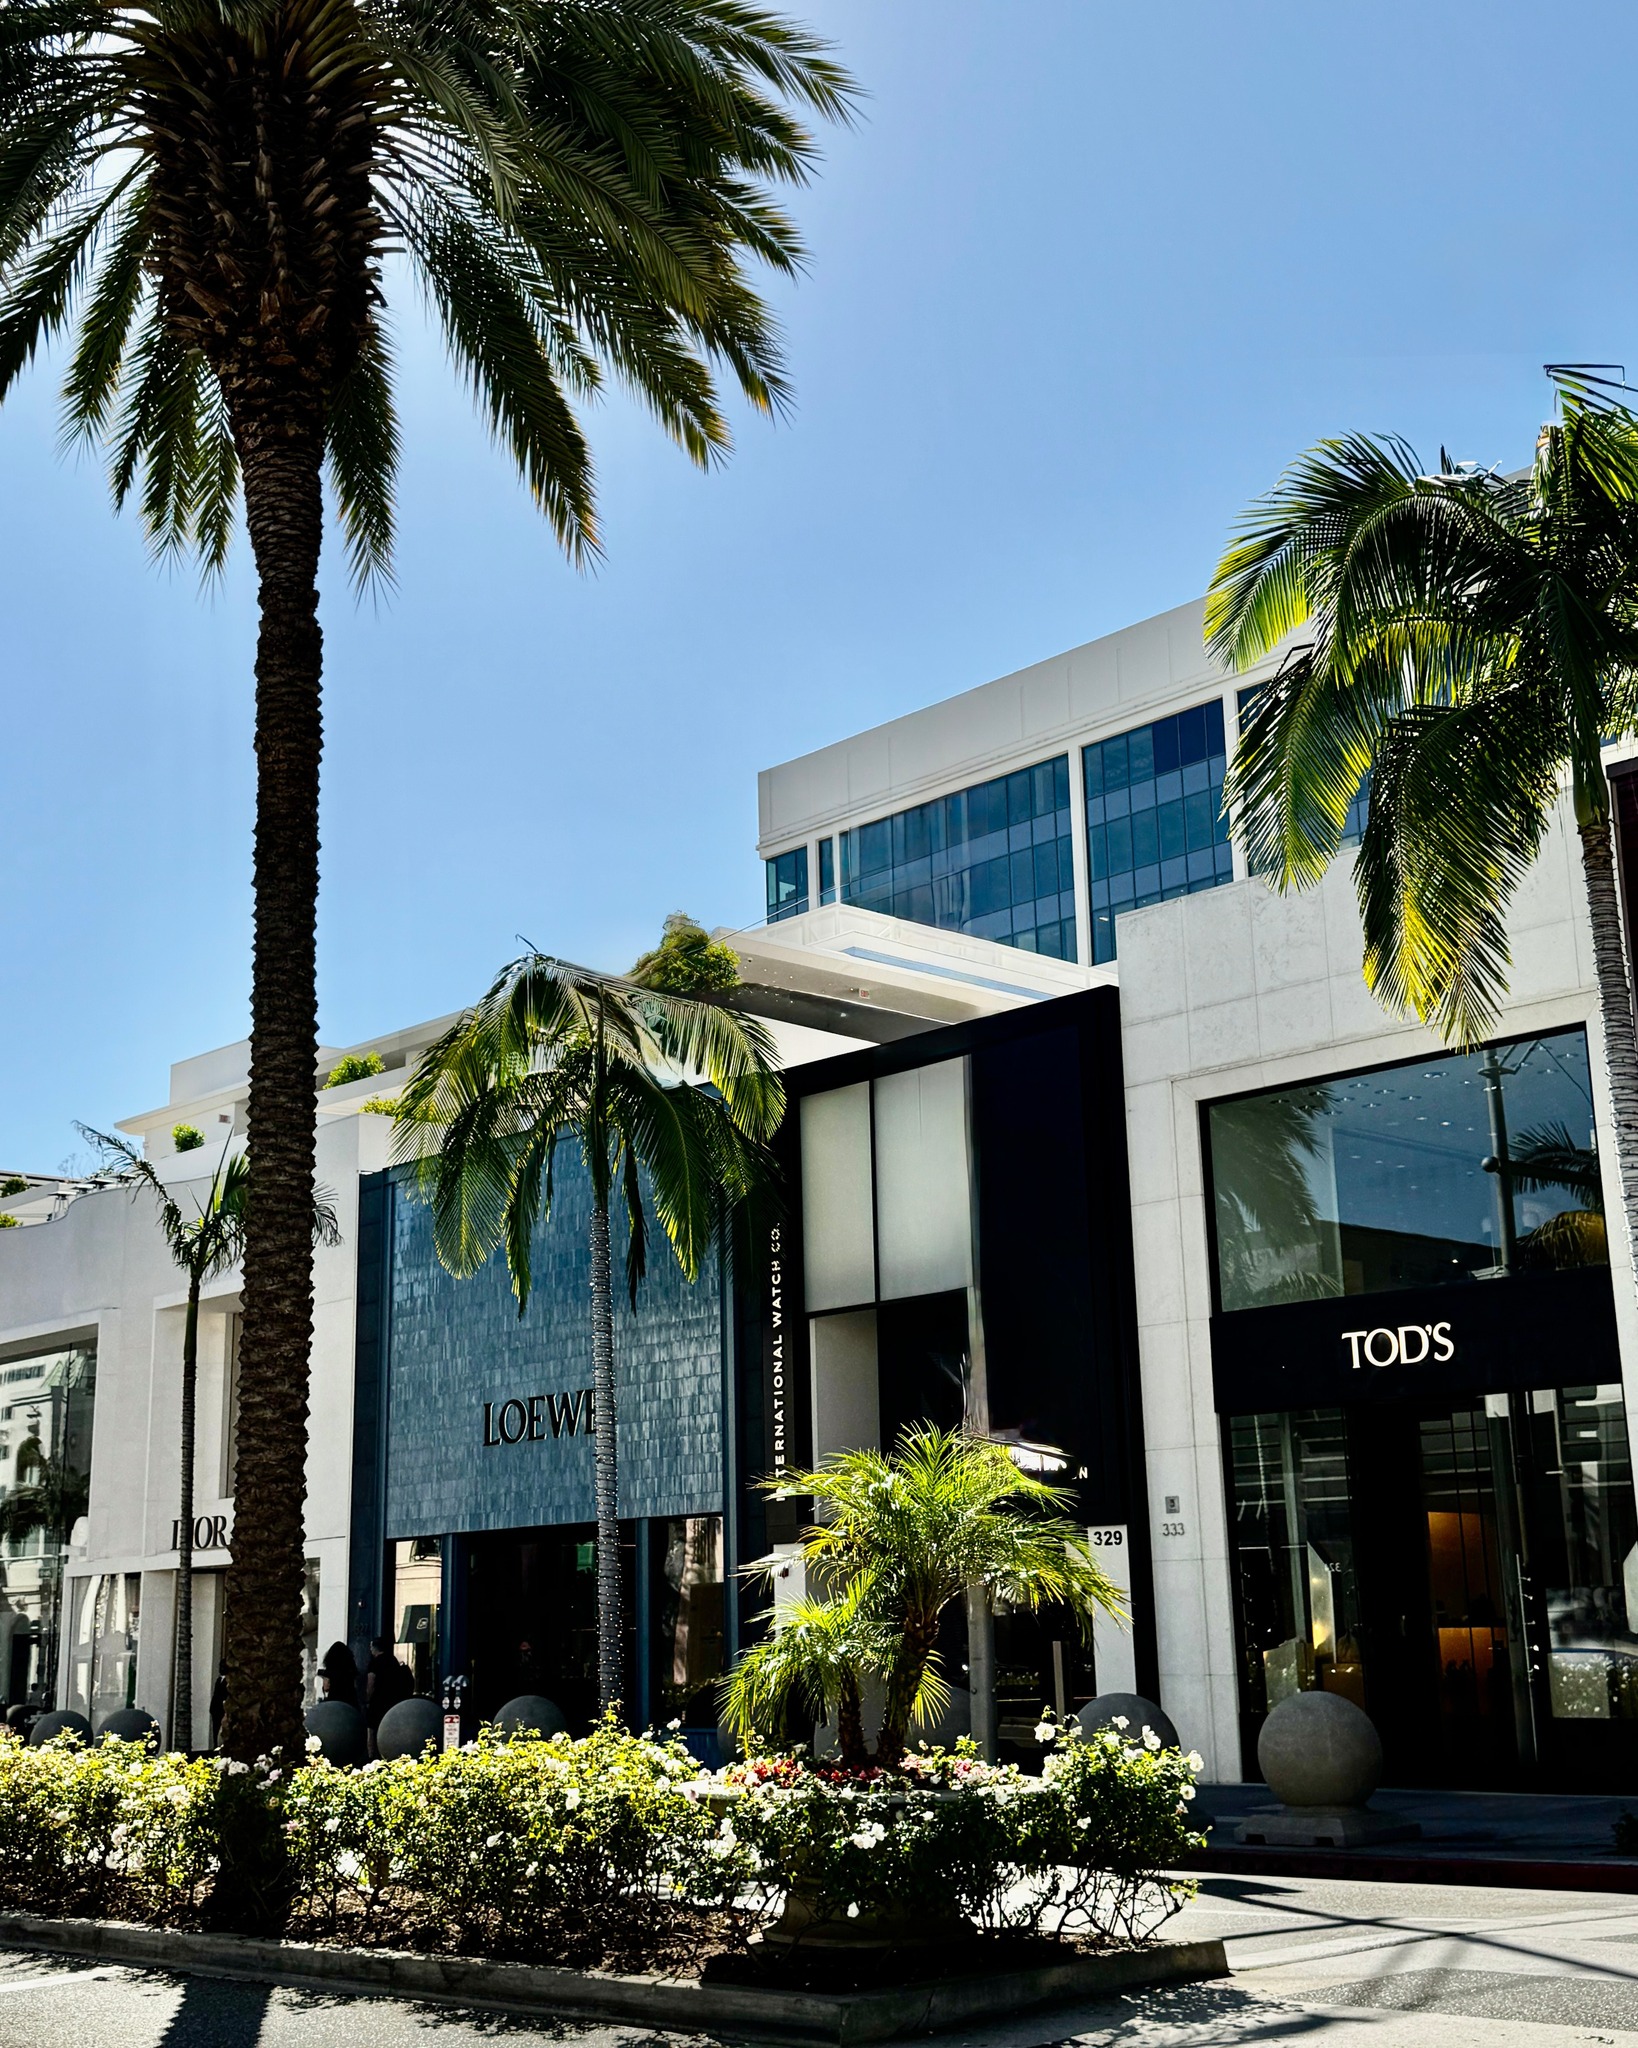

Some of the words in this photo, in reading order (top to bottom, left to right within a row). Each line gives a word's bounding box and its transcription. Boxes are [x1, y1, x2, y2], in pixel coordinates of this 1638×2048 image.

[771, 1259, 783, 1329] WATCH
[1341, 1321, 1455, 1369] TOD'S
[1093, 1530, 1123, 1546] 329
[1162, 1522, 1186, 1537] 333
